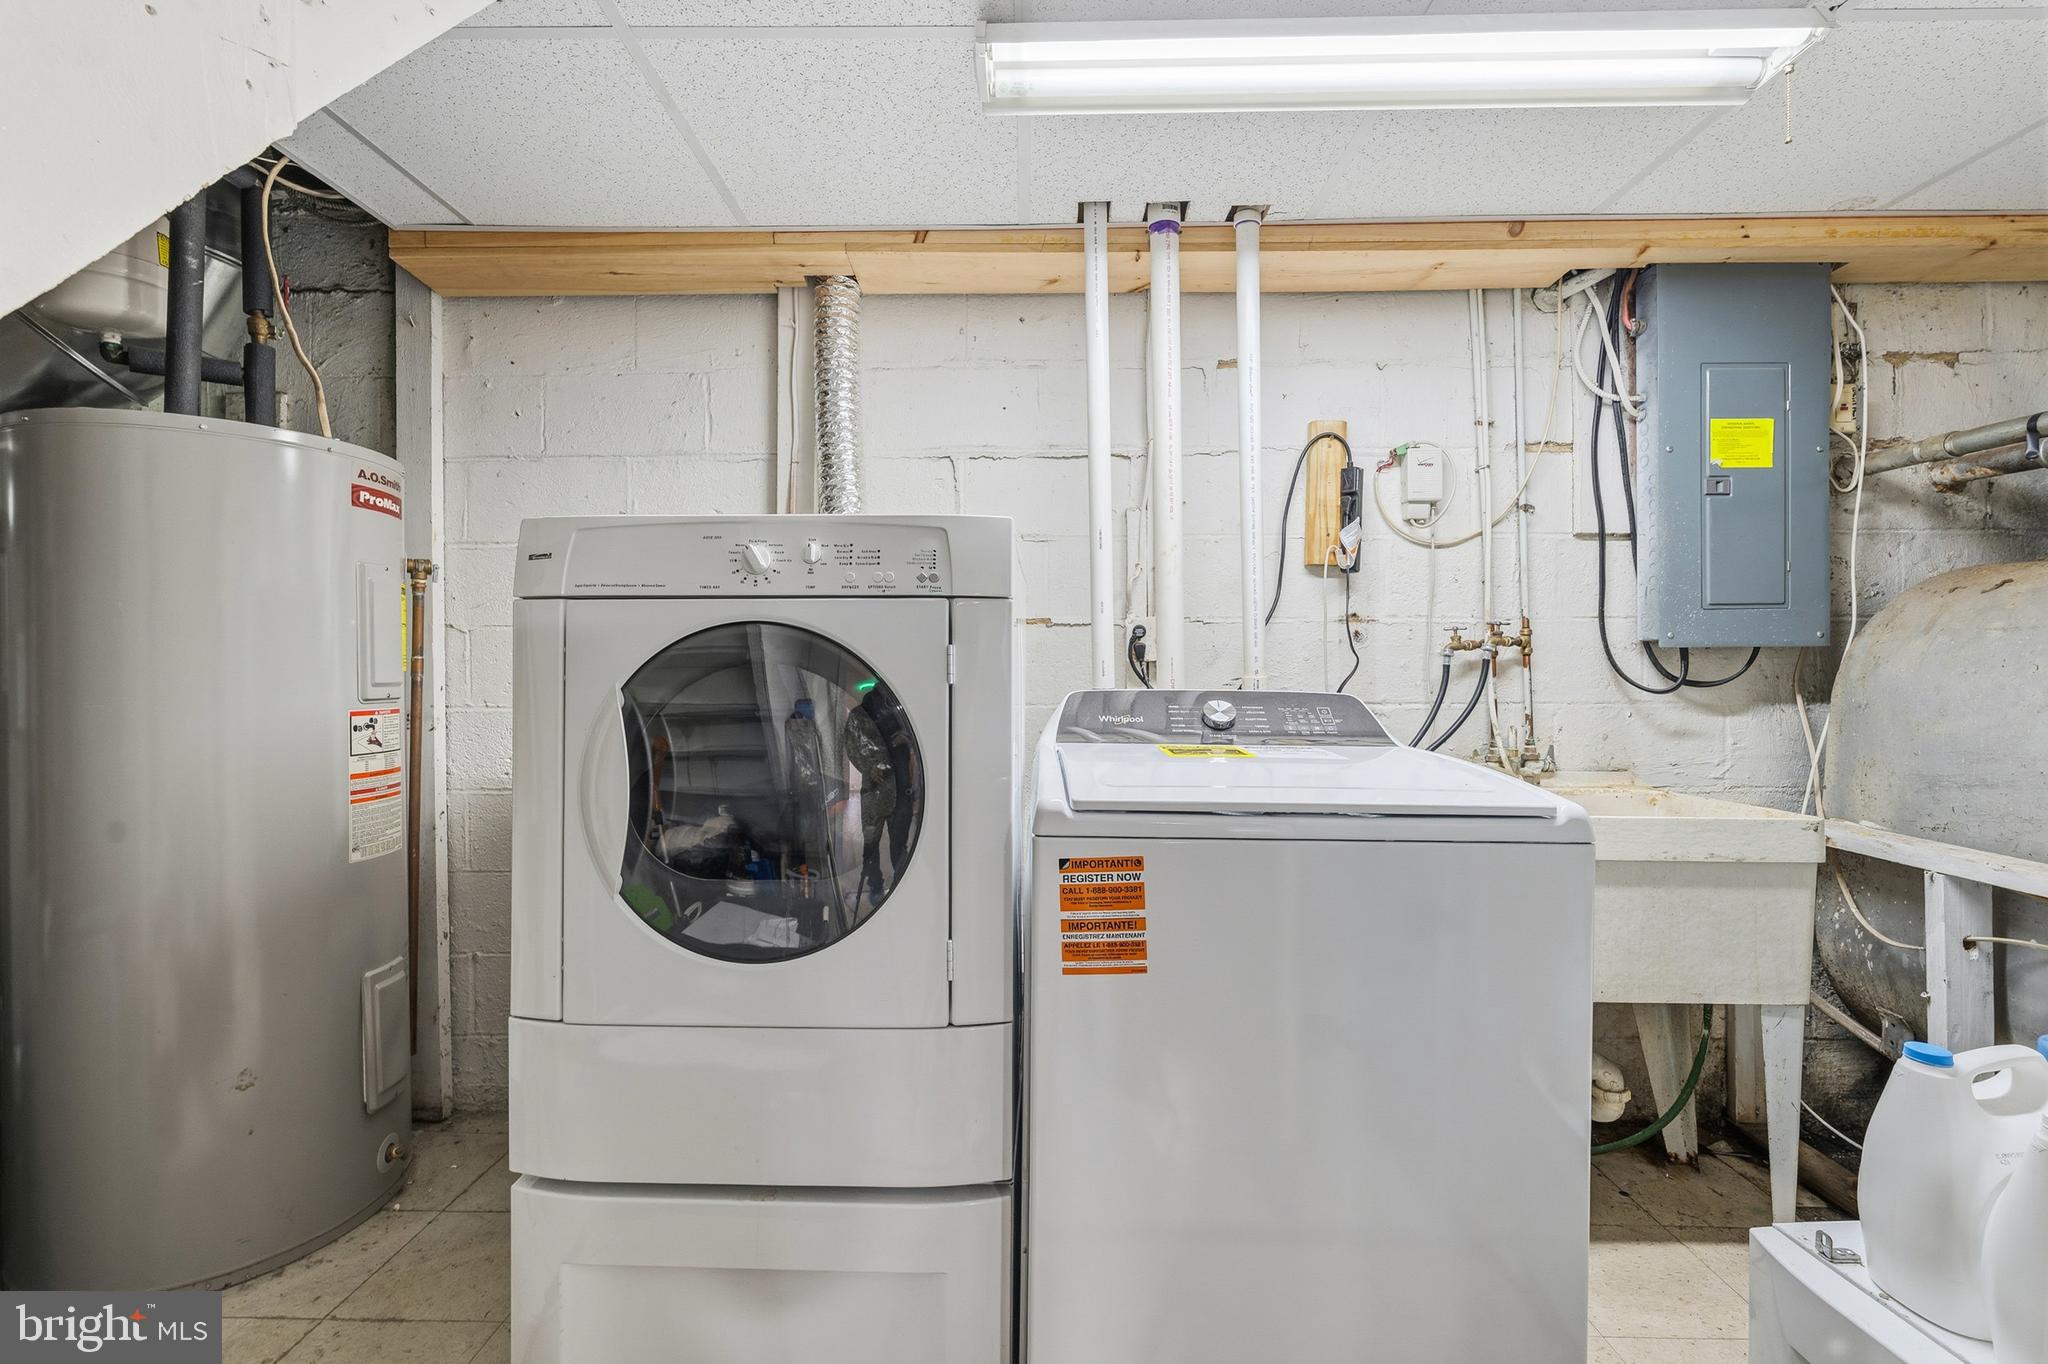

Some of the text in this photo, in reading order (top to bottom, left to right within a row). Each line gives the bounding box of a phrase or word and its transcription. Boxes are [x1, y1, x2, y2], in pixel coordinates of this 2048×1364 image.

[359, 490, 401, 514] ProMax
[1098, 714, 1144, 725] Whirlpool
[1062, 872, 1142, 884] REGISTER NOW
[1062, 887, 1084, 895] CALL
